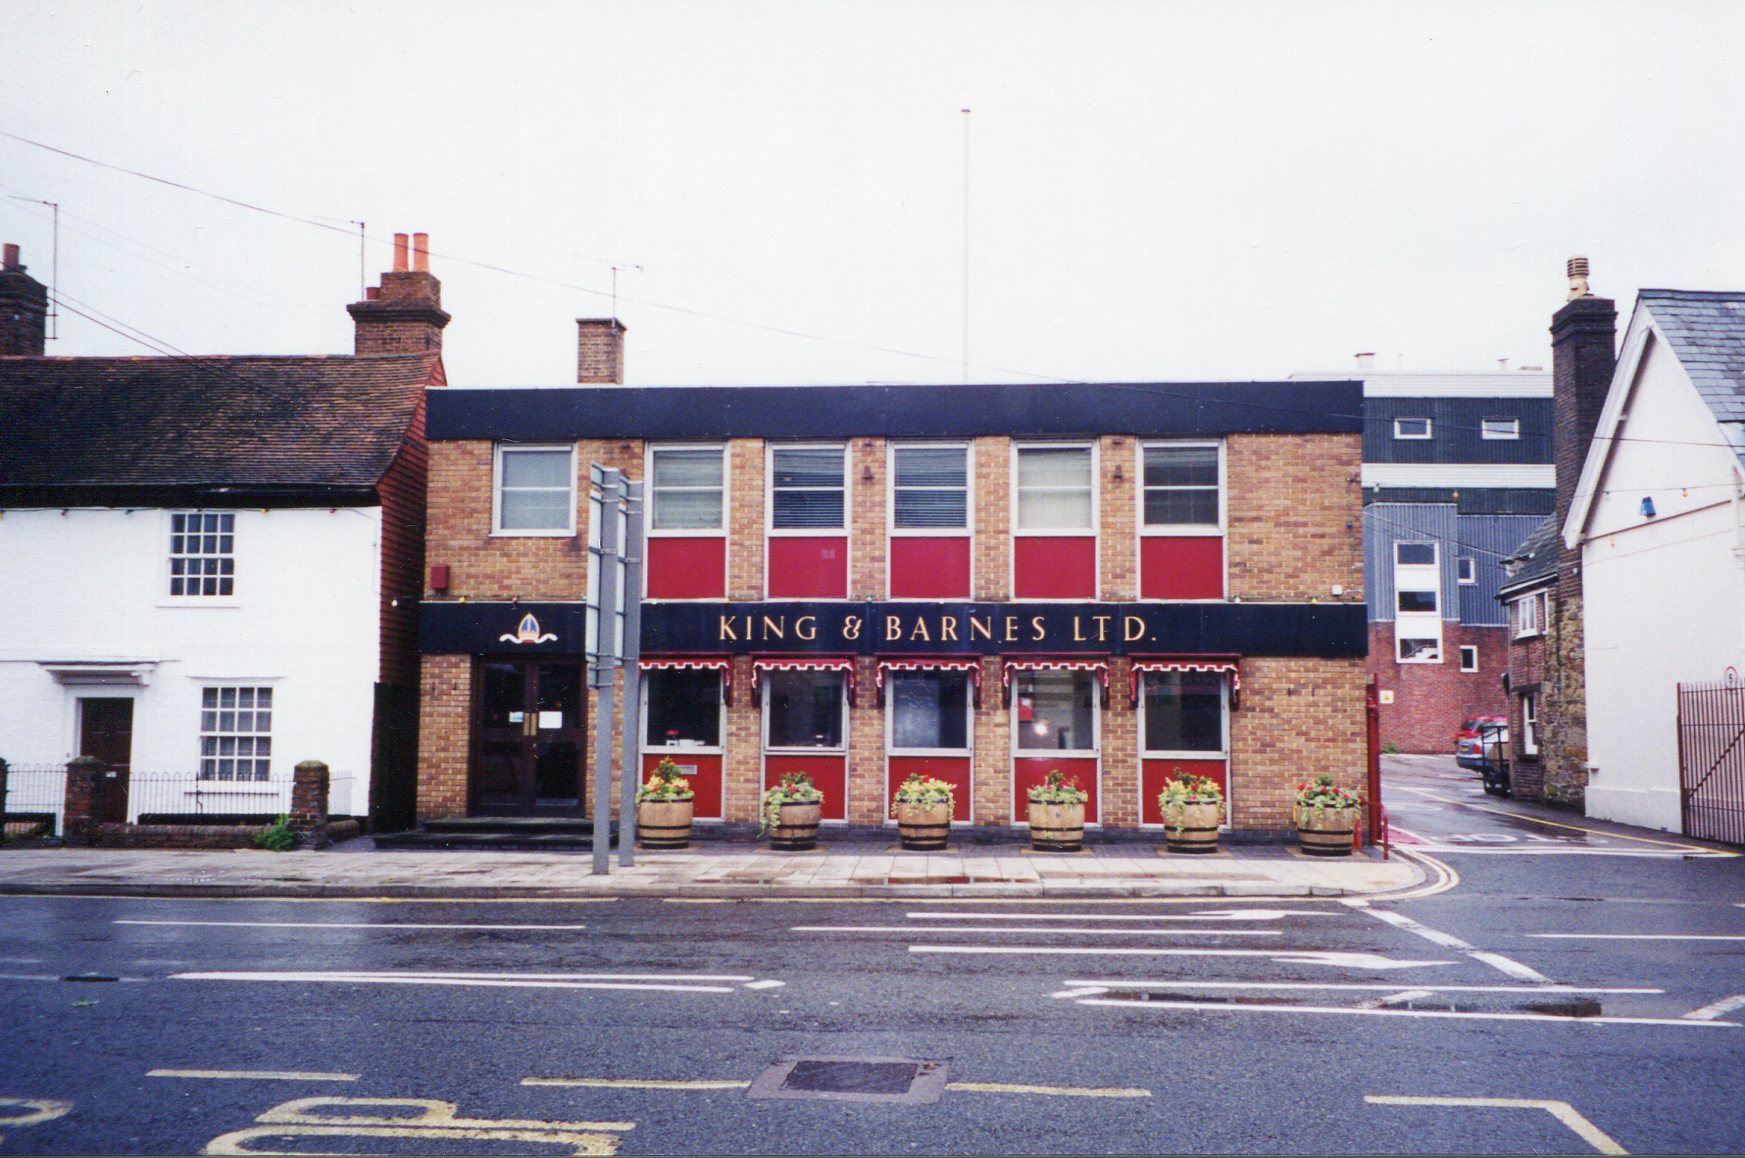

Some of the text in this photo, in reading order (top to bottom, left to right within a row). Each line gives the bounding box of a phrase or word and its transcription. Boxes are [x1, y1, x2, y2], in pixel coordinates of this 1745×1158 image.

[719, 615, 1157, 641] KING & BARNES LTD.
